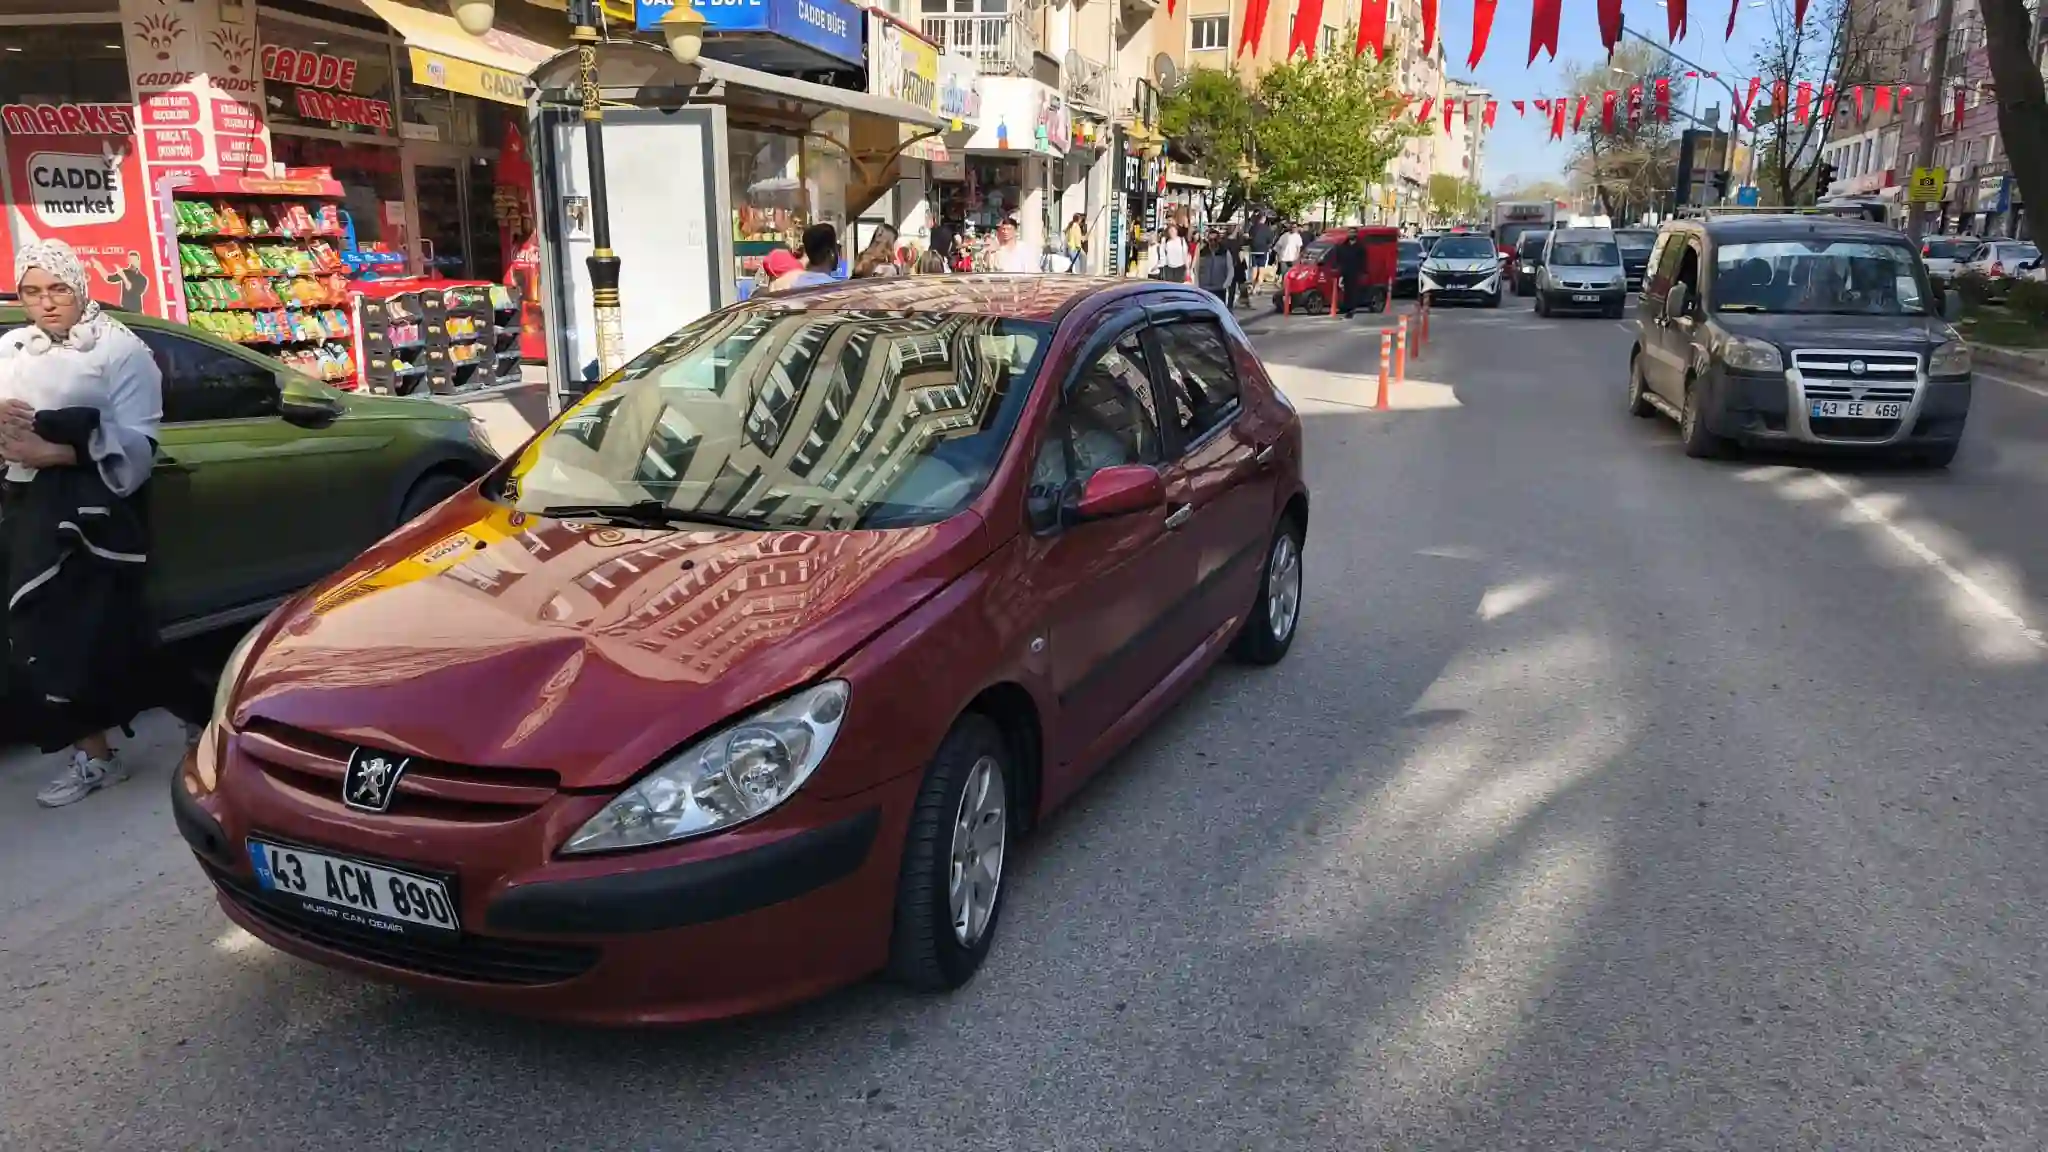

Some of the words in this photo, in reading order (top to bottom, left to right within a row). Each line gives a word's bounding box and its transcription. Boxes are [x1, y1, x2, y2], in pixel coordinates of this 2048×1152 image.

[798, 1, 826, 28] CADDE
[827, 11, 847, 38] BÜFE
[136, 71, 195, 86] CADDE
[208, 75, 260, 92] CADDE
[261, 44, 357, 92] CADDE
[901, 67, 936, 109] PETSHOP
[1, 103, 136, 134] MARKET
[295, 87, 393, 129] MARKET
[33, 165, 118, 191] CADDE
[1125, 155, 1139, 192] PET
[44, 195, 115, 214] market
[1822, 402, 1837, 415] 43
[1848, 403, 1863, 416] EE
[1875, 404, 1898, 417] 469
[271, 850, 307, 892] 43
[324, 860, 378, 910] ACN
[388, 876, 449, 924] 890
[302, 901, 338, 918] MURAT
[342, 912, 366, 925] CAN
